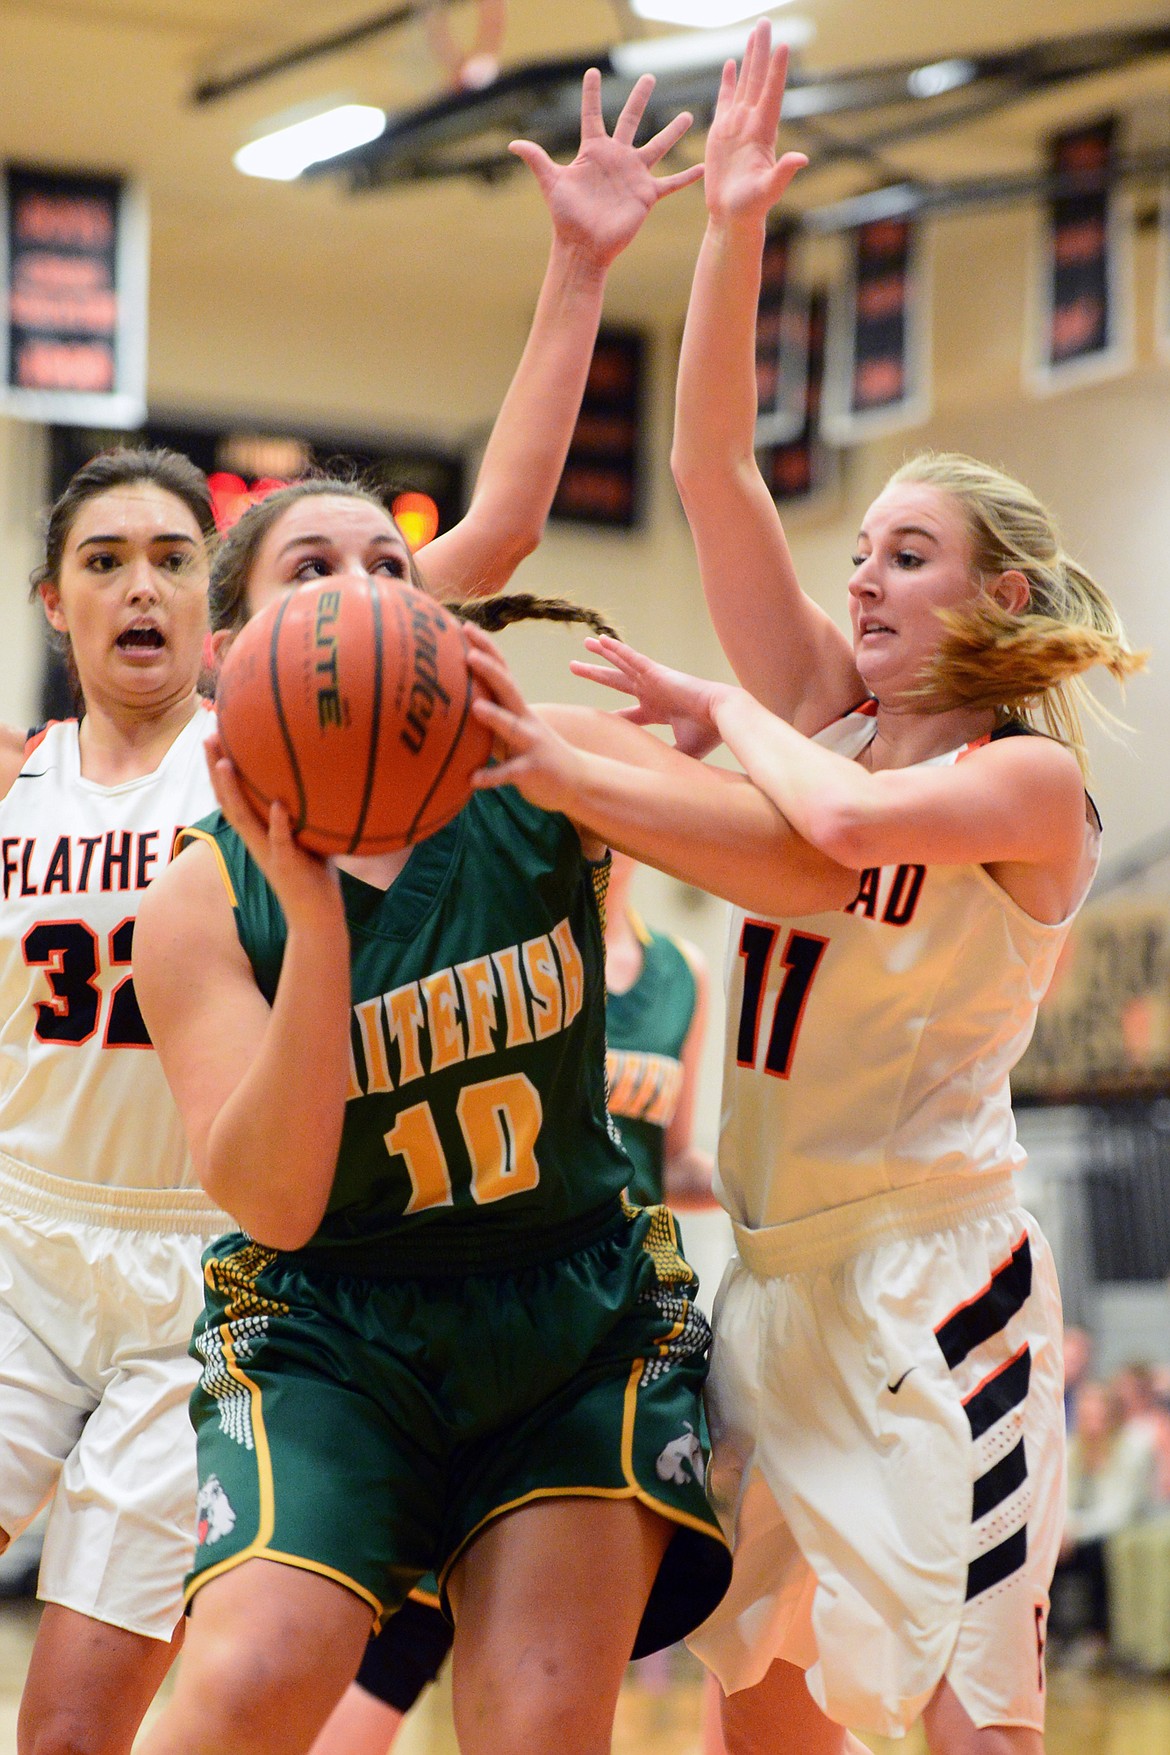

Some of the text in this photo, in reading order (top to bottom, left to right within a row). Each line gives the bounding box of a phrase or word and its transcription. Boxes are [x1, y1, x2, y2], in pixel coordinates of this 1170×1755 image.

[315, 590, 342, 729] ELITE
[1, 826, 186, 901] FLATHE
[345, 917, 584, 1101] ITEFISH
[736, 917, 831, 1081] 11
[383, 1072, 543, 1215] 10
